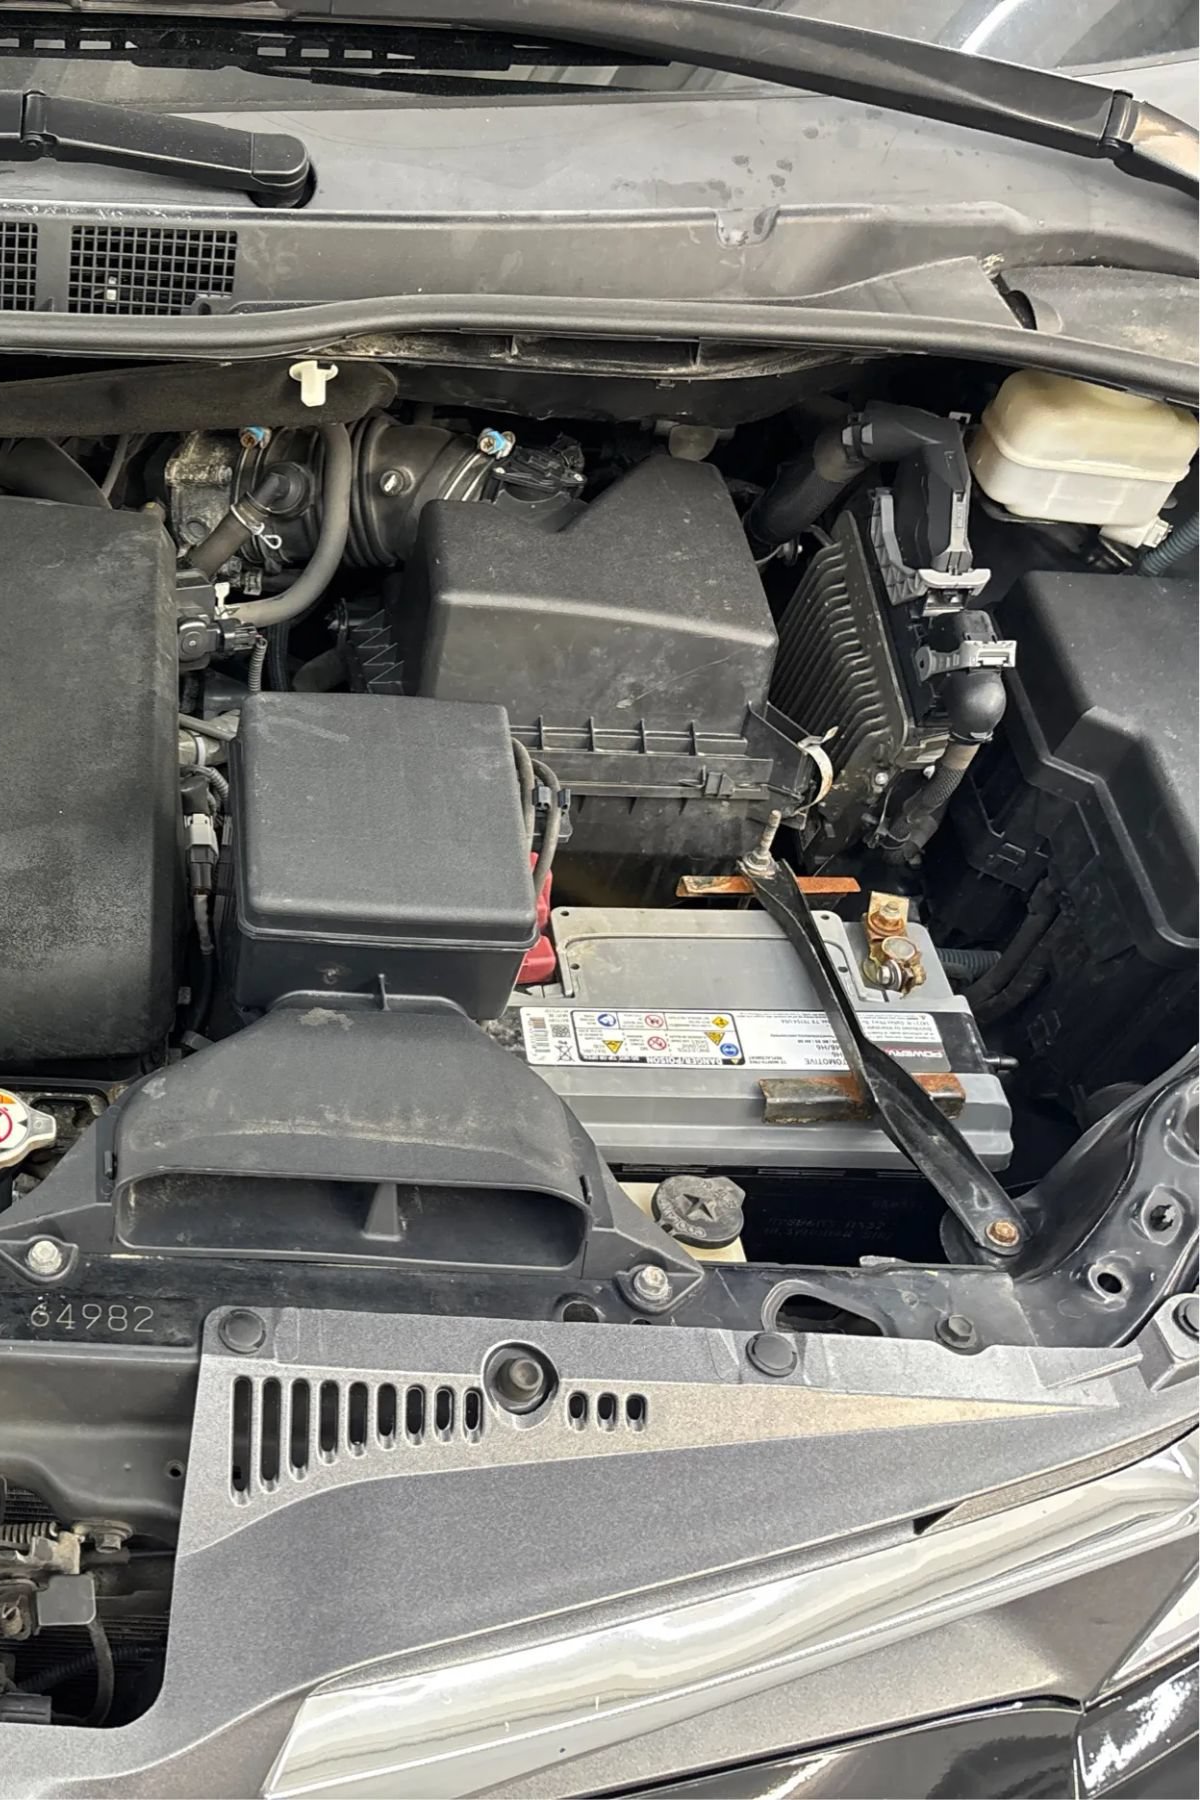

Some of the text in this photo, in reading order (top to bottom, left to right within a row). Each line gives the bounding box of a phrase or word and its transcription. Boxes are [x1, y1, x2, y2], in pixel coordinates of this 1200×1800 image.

[882, 1048, 944, 1058] POWERV
[647, 1056, 723, 1065] DANGER/POISON
[804, 1057, 848, 1066] TOMOTIVE
[30, 1302, 155, 1333] 64982
